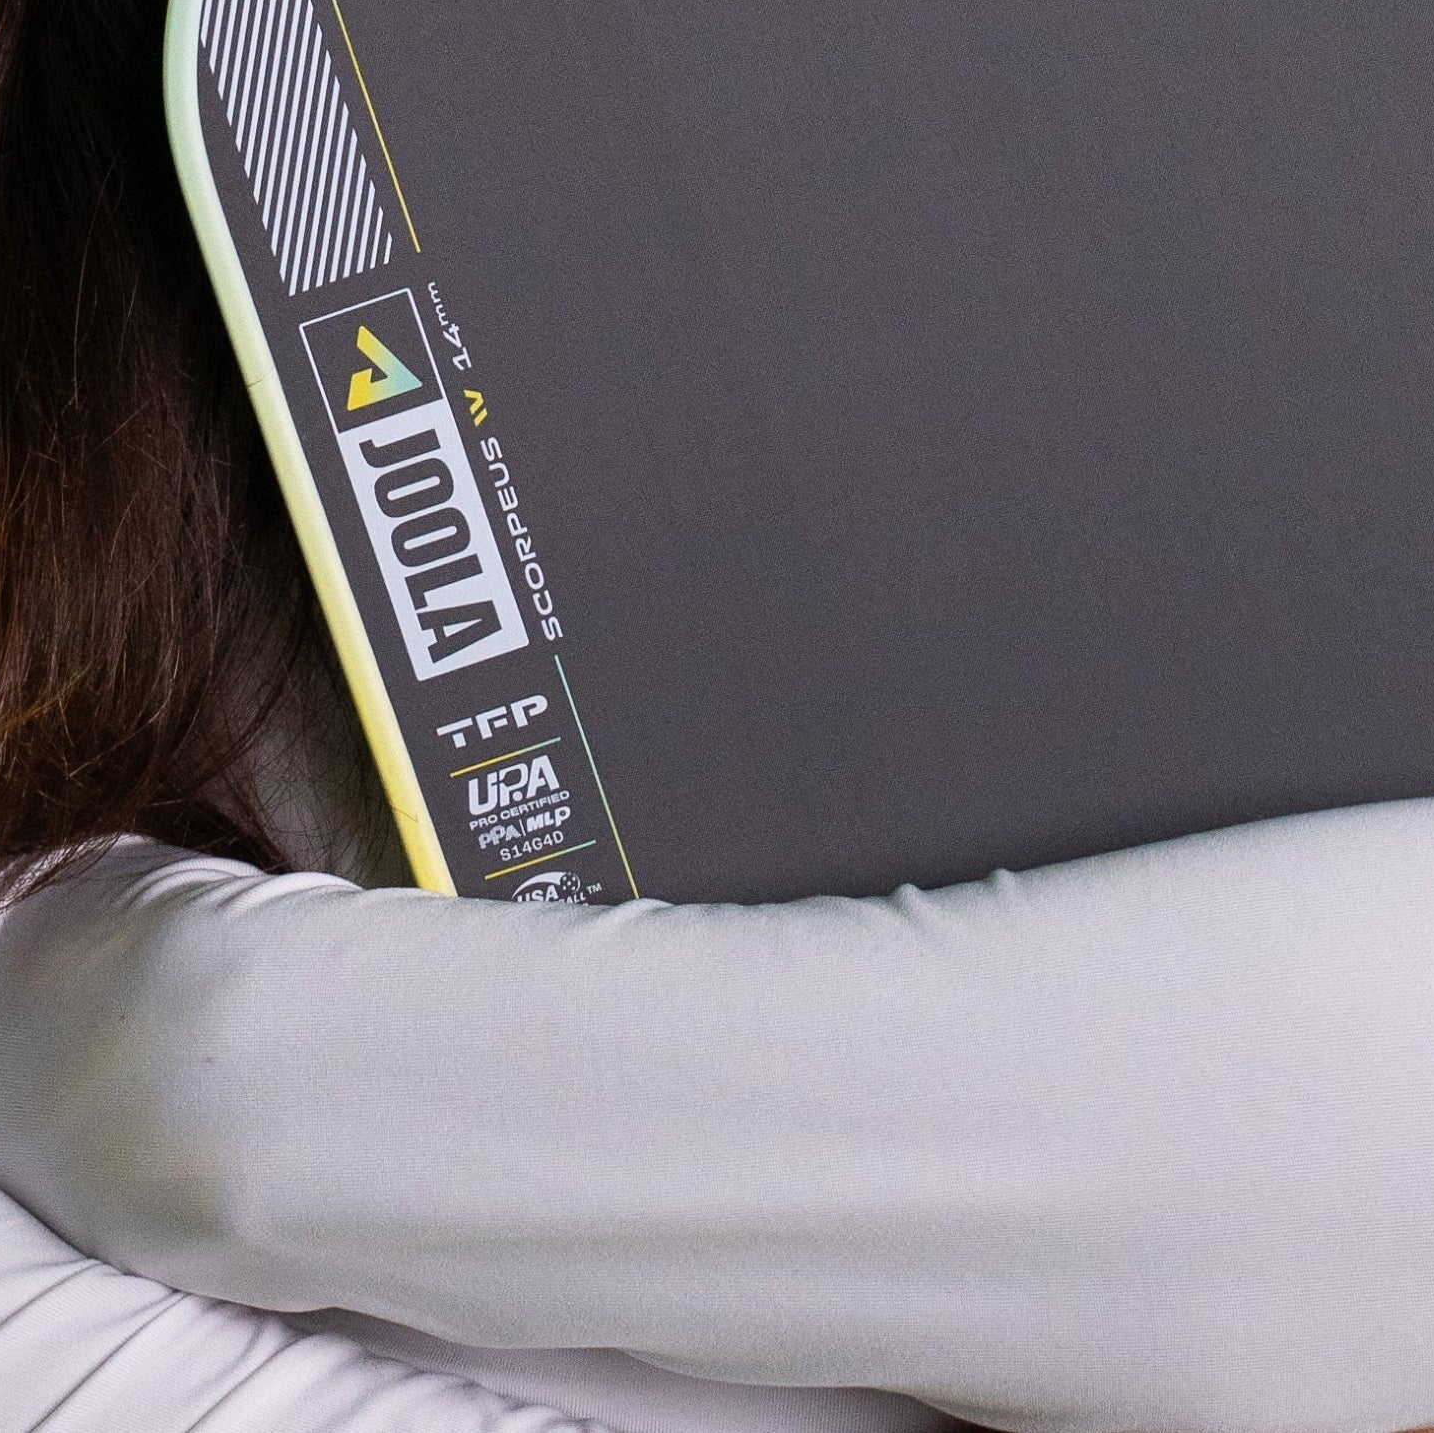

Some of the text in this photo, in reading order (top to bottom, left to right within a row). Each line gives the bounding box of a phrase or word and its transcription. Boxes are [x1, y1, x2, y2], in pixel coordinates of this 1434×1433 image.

[358, 428, 503, 664] JOOLA
[480, 436, 564, 642] SCORPEUS
[436, 694, 548, 749] TFP
[469, 790, 570, 831] PRO CERTIFIED
[499, 830, 564, 861] S14G4D
